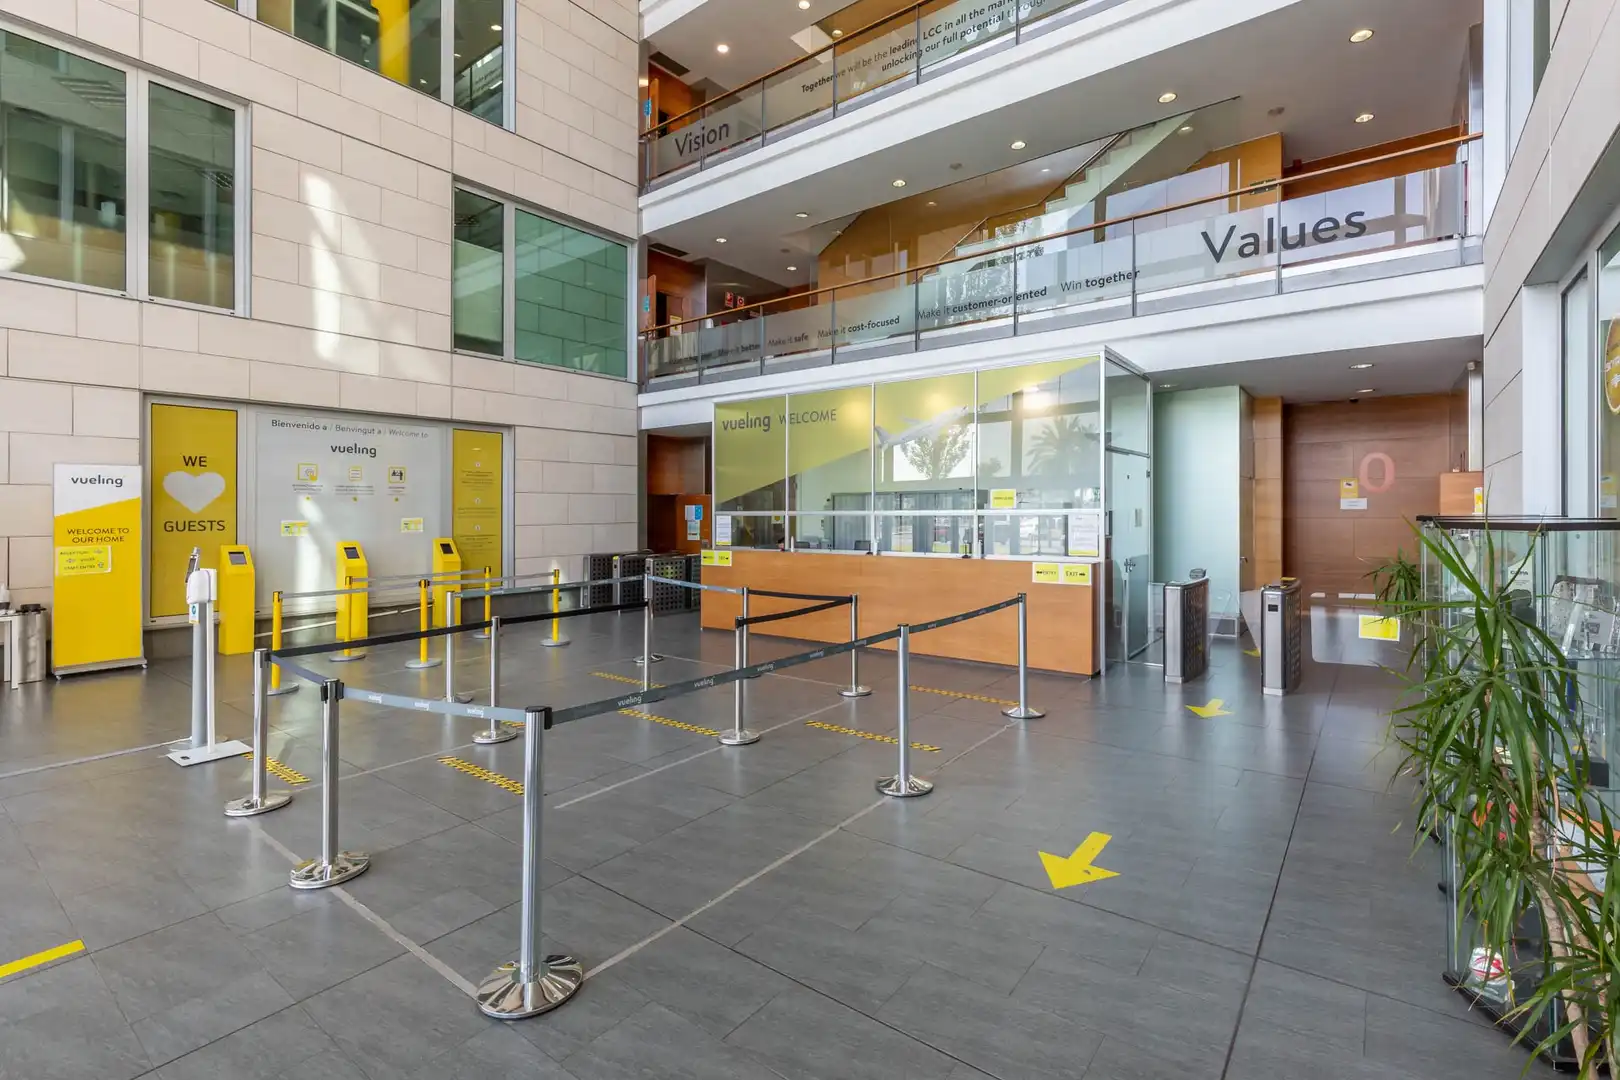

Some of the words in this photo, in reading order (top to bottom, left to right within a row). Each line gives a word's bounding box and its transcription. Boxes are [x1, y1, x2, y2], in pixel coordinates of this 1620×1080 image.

[801, 72, 834, 93] Together
[862, 56, 873, 68] be
[874, 50, 888, 62] the
[889, 37, 919, 55] leadin
[923, 24, 943, 40] LCC
[944, 19, 954, 31] in
[955, 13, 967, 26] all
[969, 5, 985, 19] the
[881, 48, 923, 72] unlocking
[925, 41, 941, 53] our
[942, 32, 958, 47] full
[960, 10, 1005, 41] potential
[674, 123, 729, 157] Vision
[1200, 210, 1367, 264] Values
[1060, 280, 1082, 293] Win
[1085, 269, 1140, 289] together
[918, 307, 941, 320] Make
[943, 305, 951, 315] it
[952, 286, 1047, 314] customer-orented
[847, 315, 900, 333] cost-focused
[794, 333, 809, 341] safe
[271, 419, 321, 431] Bienvenido
[335, 423, 375, 435] Benvingut
[722, 411, 771, 432] vueling
[779, 408, 837, 425] WELCOME
[330, 442, 377, 458] vueling
[182, 455, 208, 468] WE
[70, 474, 124, 488] vueling
[67, 527, 116, 536] WELCOME
[163, 519, 226, 533] GUESTS
[72, 536, 95, 544] OUR
[96, 535, 125, 543] HOME
[617, 694, 642, 707] vueling
